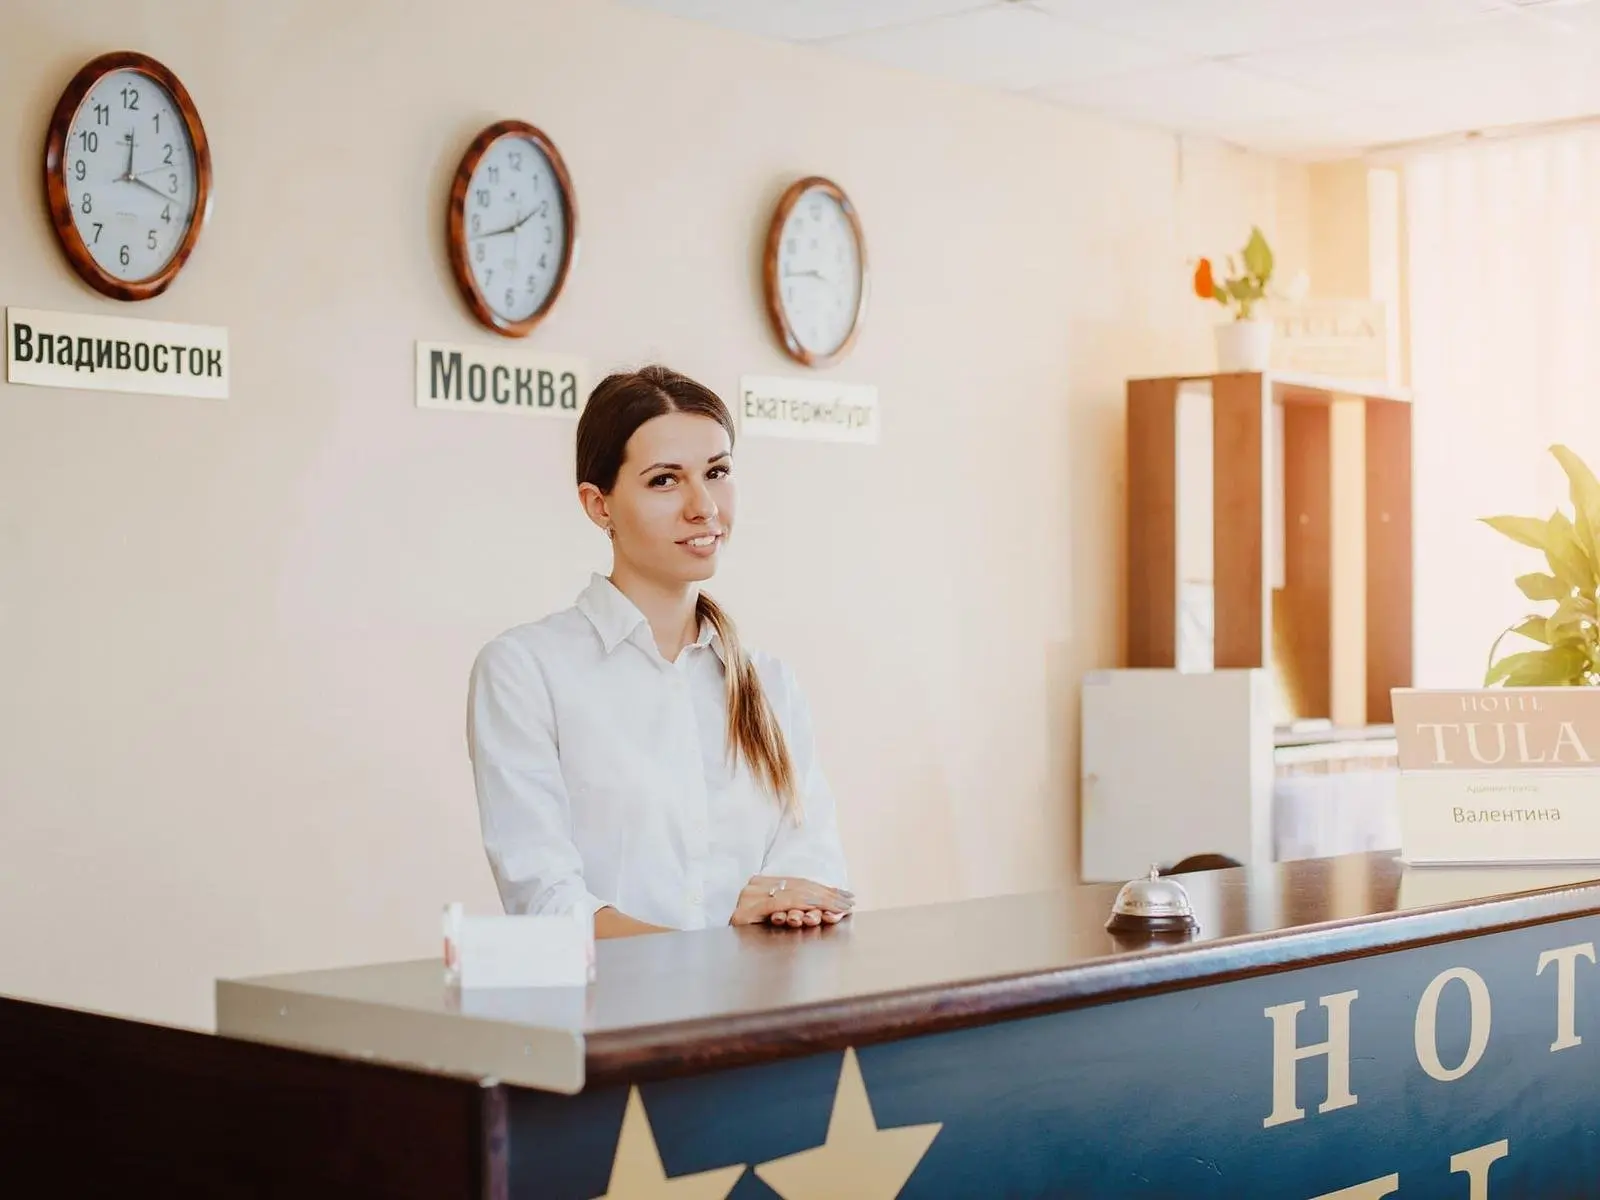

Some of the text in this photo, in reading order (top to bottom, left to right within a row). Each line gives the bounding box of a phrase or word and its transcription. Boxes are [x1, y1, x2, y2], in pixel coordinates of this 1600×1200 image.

[120, 89, 139, 111] 12
[93, 104, 110, 126] 11
[152, 113, 159, 134] 1
[79, 131, 98, 153] 10
[163, 144, 173, 165] 2
[75, 160, 86, 181] 9
[168, 174, 178, 194] 3
[82, 193, 92, 214] 8
[160, 203, 171, 224] 4
[92, 223, 103, 243] 7
[147, 230, 157, 250] 5
[119, 245, 130, 265] 6
[14, 323, 222, 377] Владивосток
[430, 350, 577, 409] Москва
[1416, 721, 1595, 764] TULA
[1453, 807, 1561, 823] Валентина
[1263, 942, 1597, 1129] HOT
